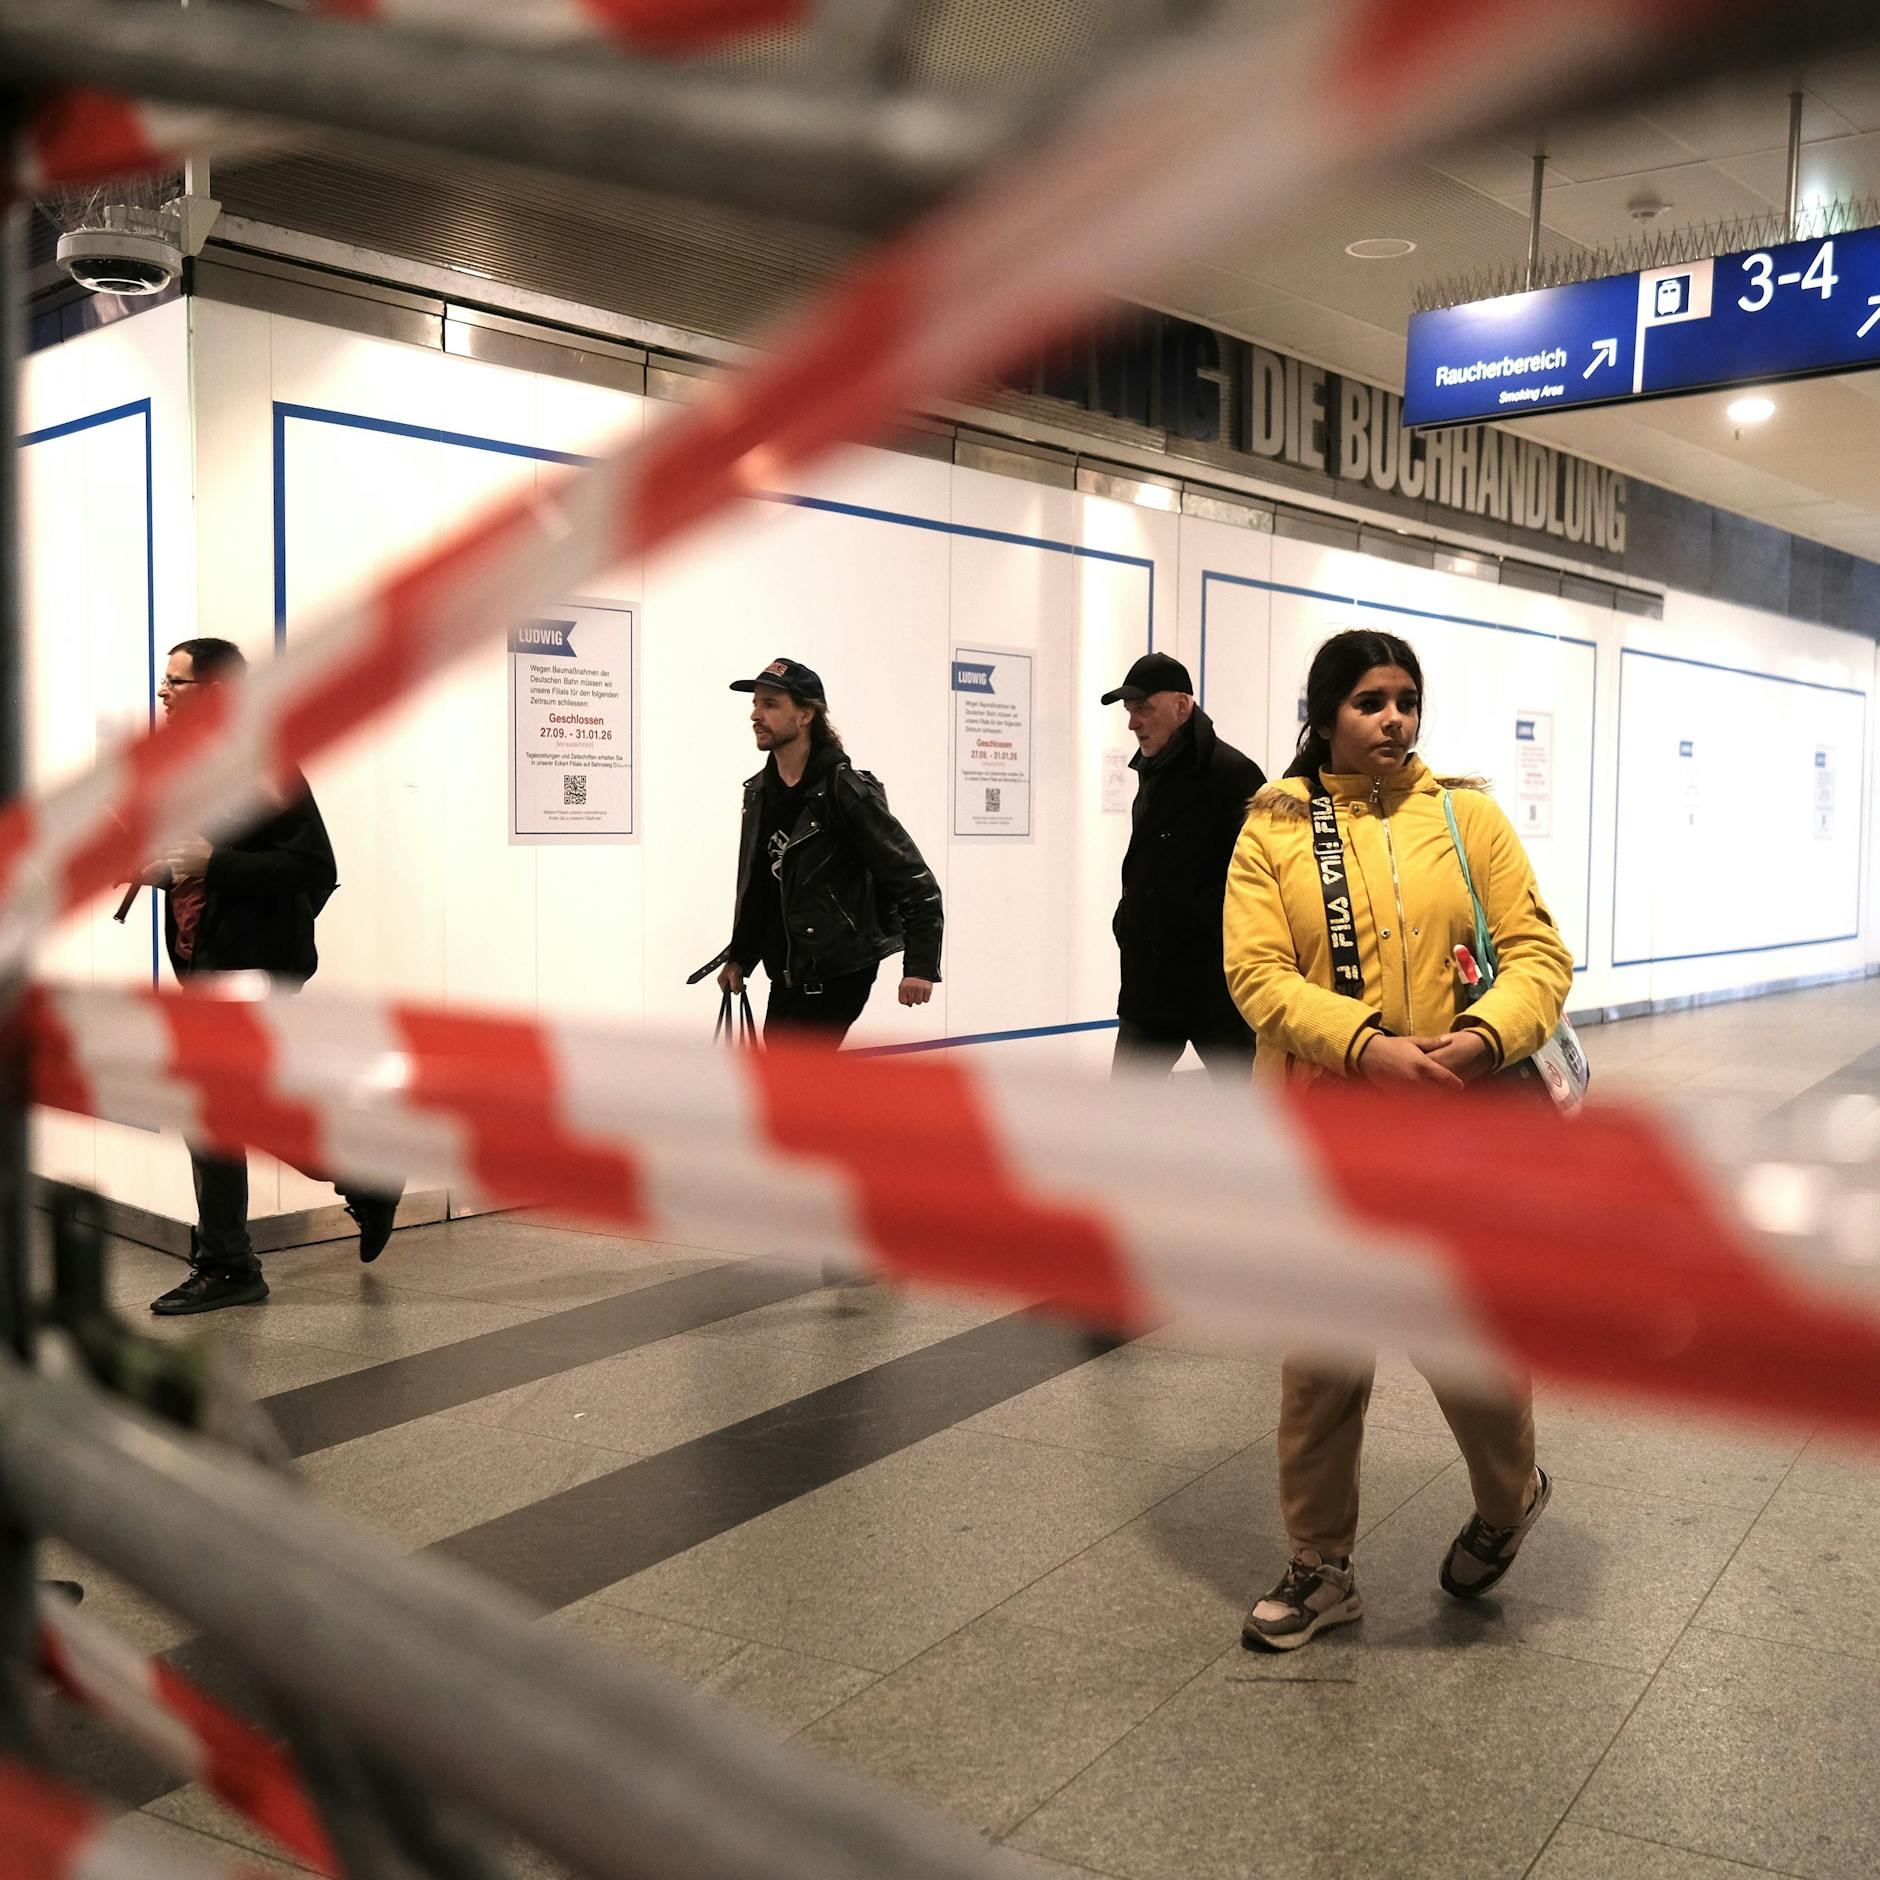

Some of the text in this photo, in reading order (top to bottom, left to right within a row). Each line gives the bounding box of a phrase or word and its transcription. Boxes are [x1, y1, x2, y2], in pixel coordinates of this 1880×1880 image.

[1737, 242, 1838, 312] 3-4
[1436, 347, 1567, 387] Raucherbereich
[1499, 384, 1563, 405] Smoking Area
[1251, 347, 1326, 466] DIE
[1339, 378, 1627, 553] BUCHHANDLUNG
[518, 628, 563, 646] LUDWIG
[530, 664, 551, 674] Wegen
[540, 727, 567, 739] 27.09.
[576, 728, 612, 740] 31.01.26
[549, 713, 604, 725] Geschlossen
[1311, 796, 1336, 834] FILA
[1327, 896, 1354, 949] FILA
